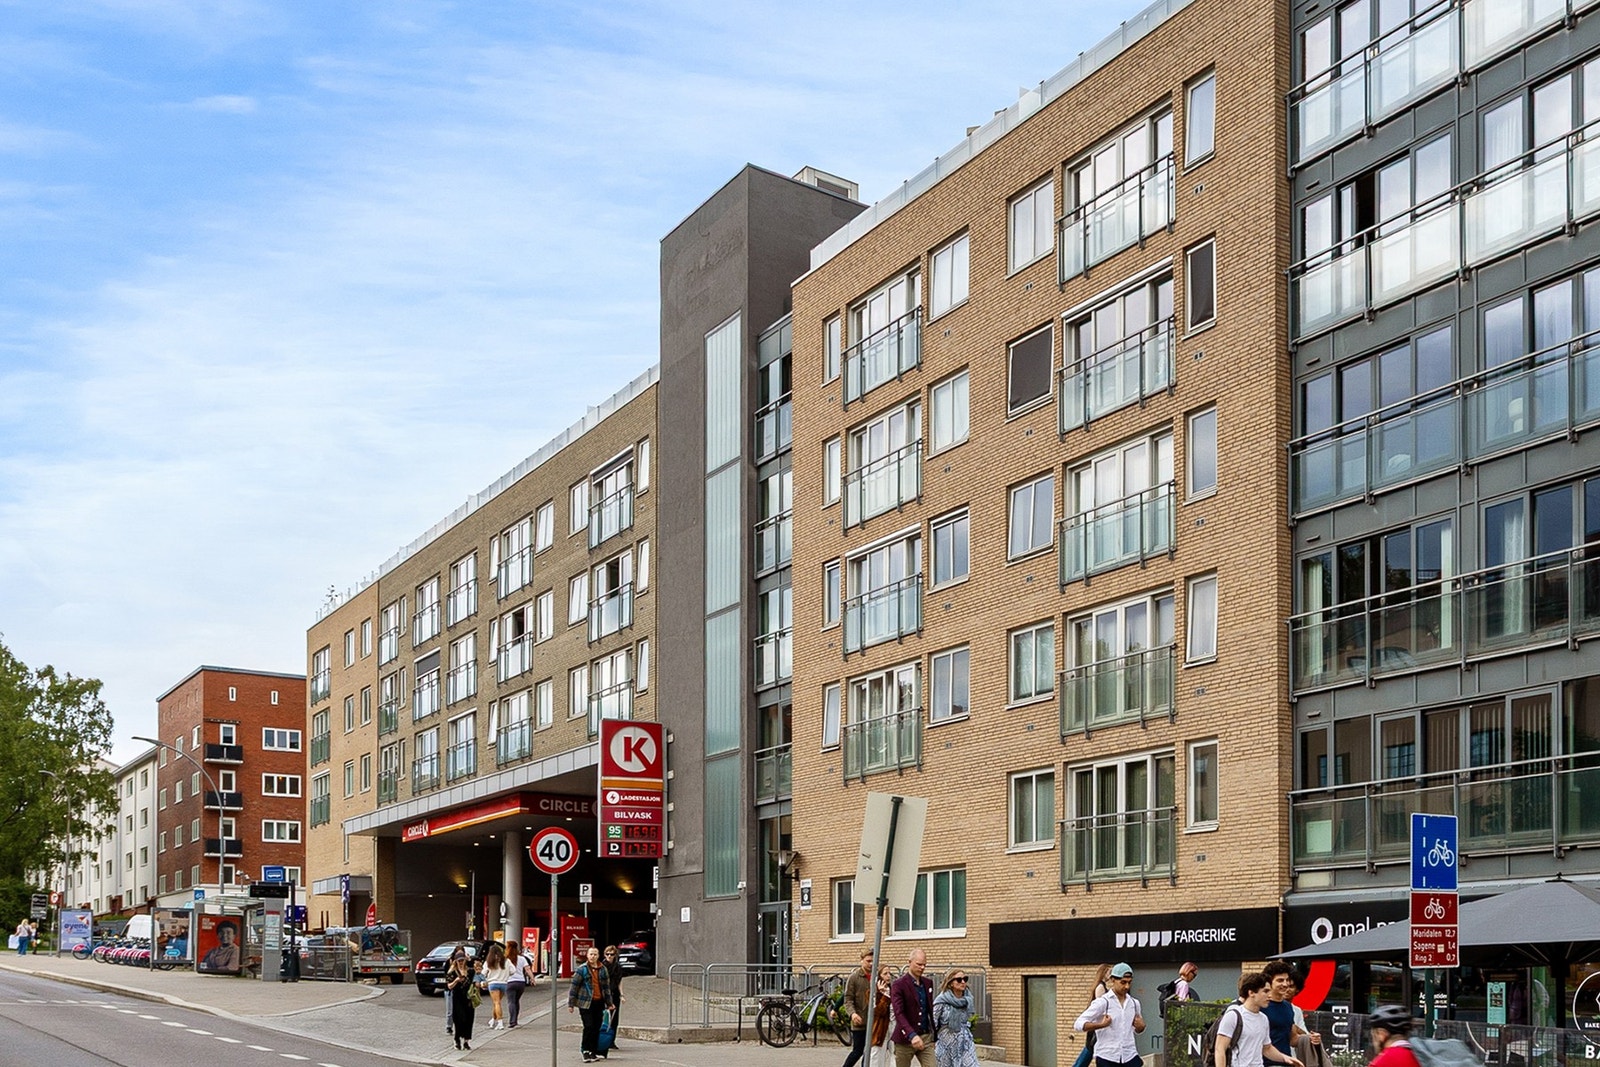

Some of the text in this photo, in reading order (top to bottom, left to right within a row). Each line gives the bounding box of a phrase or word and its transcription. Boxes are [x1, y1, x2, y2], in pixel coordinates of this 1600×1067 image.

[624, 736, 653, 769] K
[539, 799, 589, 813] CIRCLE
[614, 811, 652, 819] BILVASK
[408, 823, 423, 837] CIRCLE
[608, 826, 621, 834] 95
[539, 840, 571, 861] 40
[610, 843, 620, 851] D
[582, 885, 589, 894] P
[1174, 928, 1236, 943] FARGERIKE
[1413, 929, 1442, 937] Maridalen
[1413, 941, 1436, 952] Sagene
[1415, 954, 1427, 963] Ring
